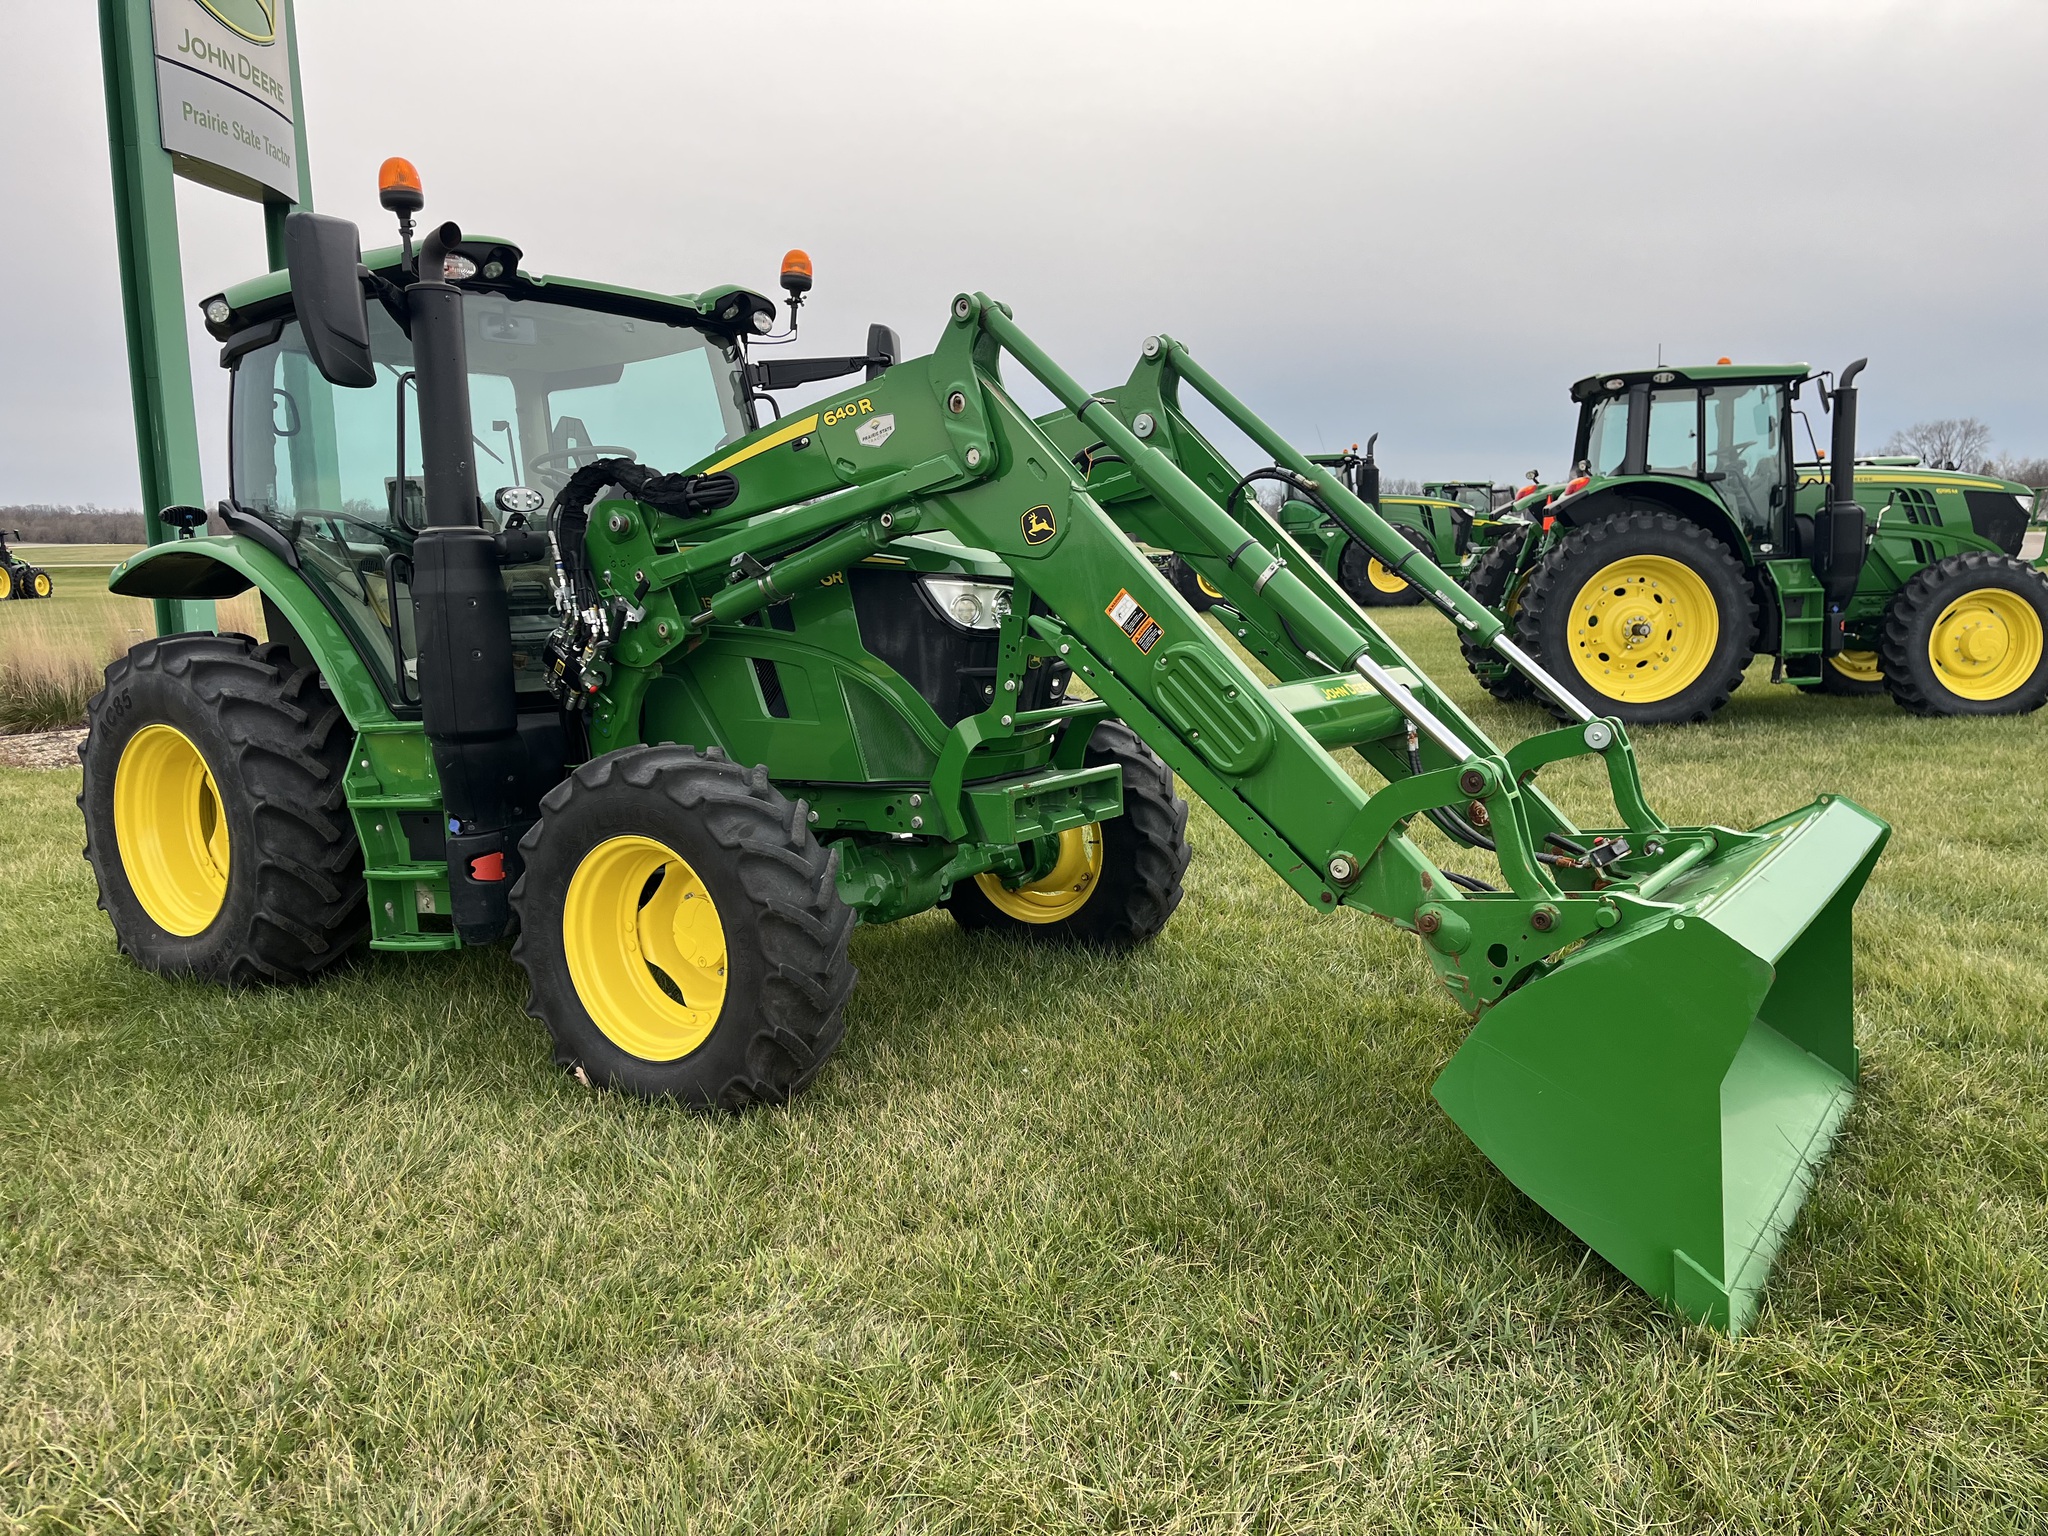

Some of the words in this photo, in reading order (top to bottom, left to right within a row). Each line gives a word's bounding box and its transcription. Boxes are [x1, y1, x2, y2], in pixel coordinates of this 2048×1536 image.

[177, 28, 235, 74] JOHN
[238, 53, 285, 105] DEERE
[182, 100, 229, 136] Prairie
[232, 121, 262, 151] State
[263, 135, 291, 169] Tractor
[879, 426, 893, 435] STATE
[1320, 687, 1350, 700] JOHN
[1343, 683, 1372, 695] DEER
